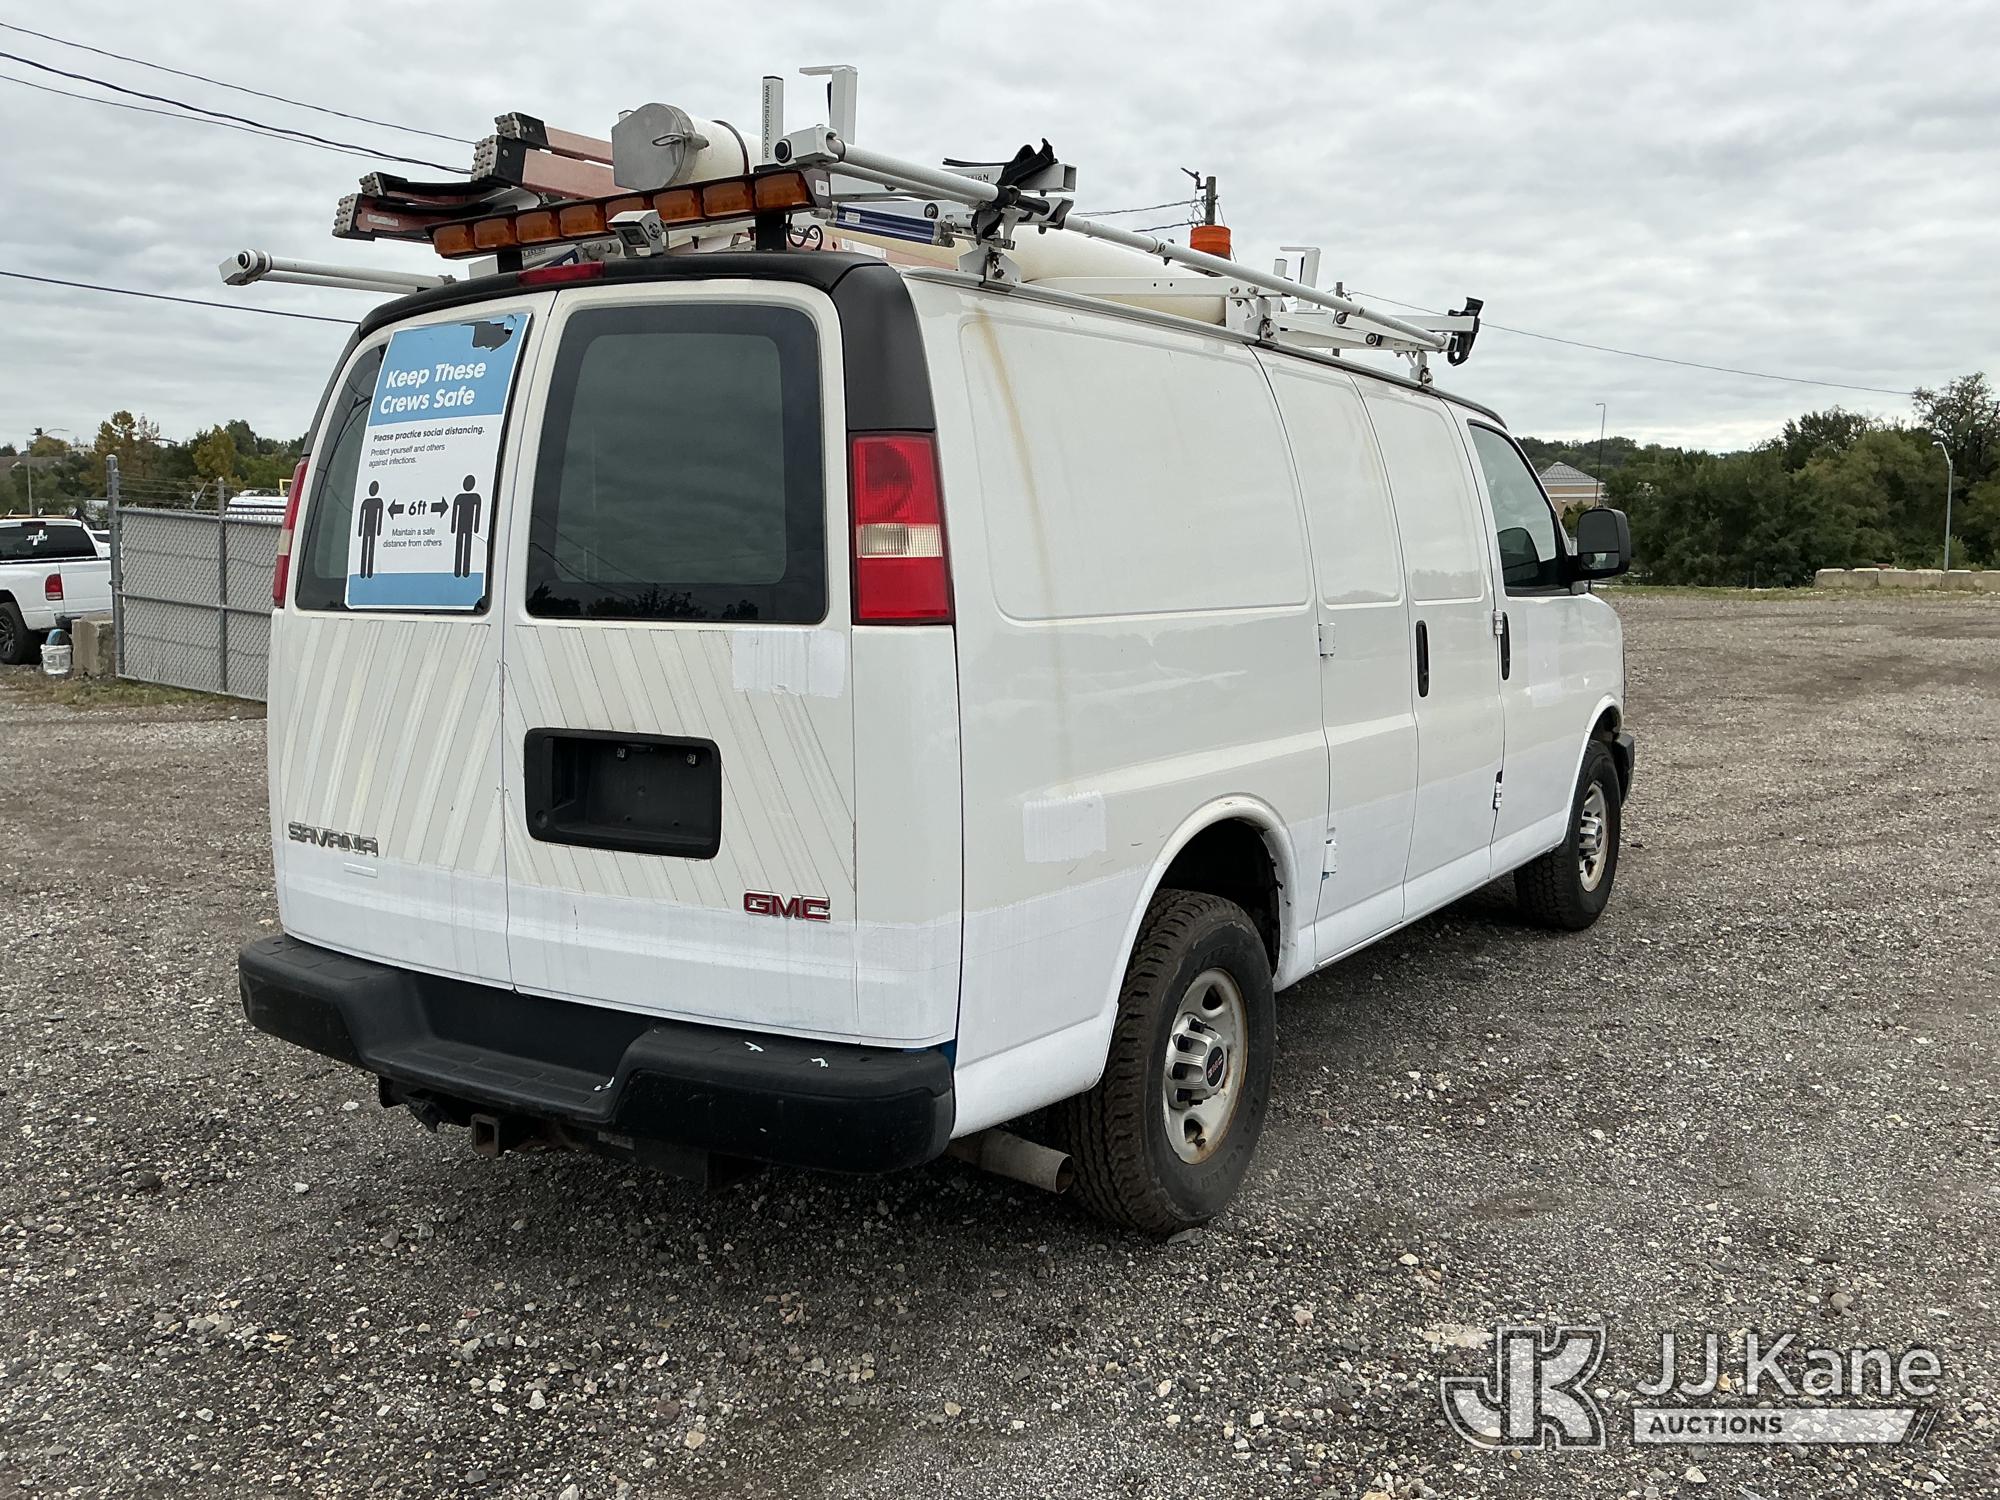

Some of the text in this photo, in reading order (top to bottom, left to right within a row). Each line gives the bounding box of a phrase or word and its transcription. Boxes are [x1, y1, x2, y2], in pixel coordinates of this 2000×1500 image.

[385, 361, 487, 389] Keep These
[380, 385, 475, 414] Crews Safe
[373, 425, 485, 443] Please practice social distancing.
[370, 443, 446, 456] Protect yourself and others
[369, 458, 388, 468] against
[408, 500, 427, 516] 6ft
[391, 528, 416, 536] Maintain
[422, 527, 435, 536] safe
[383, 539, 442, 548] distance from others
[288, 821, 379, 857] SAVANA
[743, 889, 831, 923] GMC
